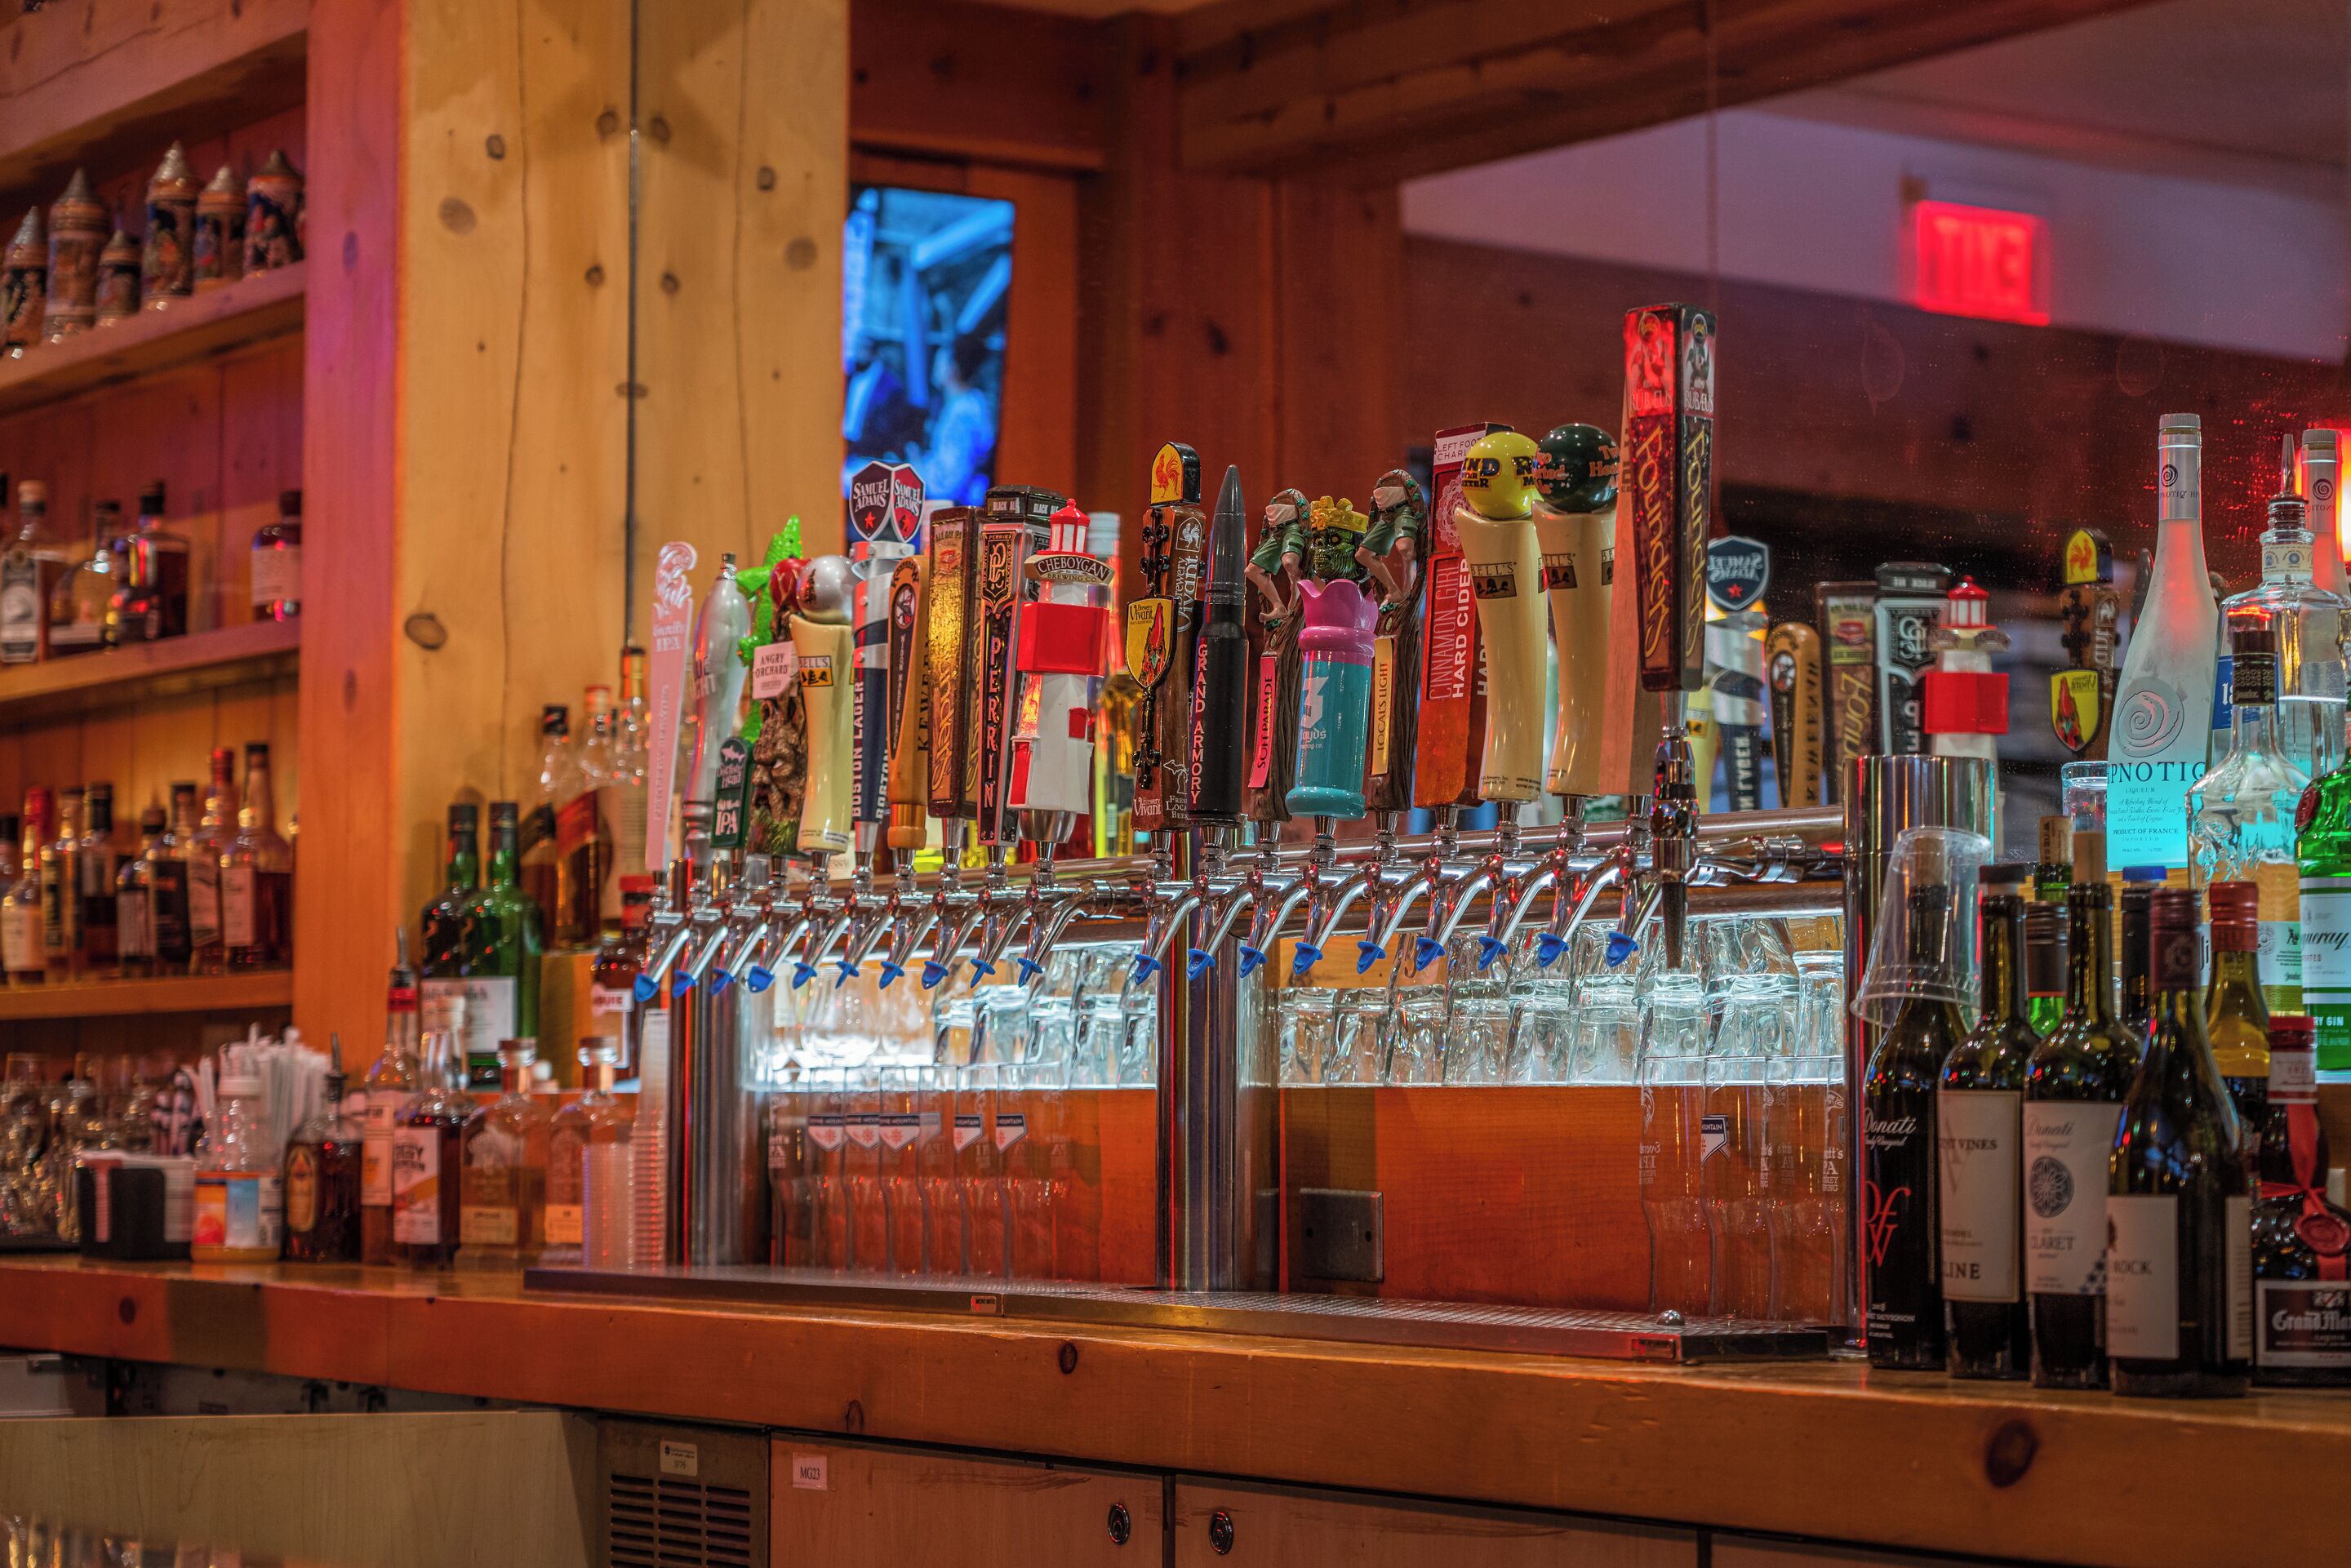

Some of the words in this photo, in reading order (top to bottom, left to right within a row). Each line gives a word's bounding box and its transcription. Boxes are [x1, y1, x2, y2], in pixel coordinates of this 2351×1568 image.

[1438, 442, 1458, 452] LEFT
[1438, 450, 1466, 460] CHARL
[1463, 458, 1500, 476] IND
[853, 478, 889, 500] SAMUEL
[894, 479, 922, 504] SAMUEL
[855, 493, 887, 513] ADAMS
[895, 496, 919, 516] ADAMS
[993, 500, 1007, 511] BLACK
[1033, 503, 1048, 513] BLACK
[1686, 429, 1706, 657] Founders
[1038, 556, 1109, 579] CHEBOYGAN
[1470, 563, 1514, 575] BELL'S
[1047, 574, 1083, 582] BREWING
[1436, 562, 1460, 600] GIRL
[1130, 604, 1153, 620] Vivant
[760, 654, 784, 665] ANGRY
[1429, 610, 1457, 700] CINNAMON
[755, 664, 789, 677] ORCHARD
[1452, 634, 1467, 698] HARD
[1195, 644, 1207, 713] GRAND
[1380, 662, 1388, 697] LIGHT
[854, 681, 864, 740] LAGER
[1262, 677, 1273, 732] PARADE
[984, 637, 1001, 808] PERRIN
[1378, 700, 1387, 751] LOCAL'S
[1257, 734, 1269, 768] SOFT
[1191, 721, 1205, 804] ARMORY
[722, 771, 742, 788] Head
[852, 746, 863, 817] BOSTON
[1134, 797, 1162, 816] Vivant
[1166, 801, 1186, 811] LOCA
[1170, 795, 1187, 803] FRES
[716, 810, 738, 836] IPA
[2313, 1016, 2323, 1025] RY
[2327, 1016, 2344, 1026] GIN
[1960, 1139, 1997, 1150] VINES
[1944, 1263, 1980, 1279] LINE
[2272, 1309, 2321, 1330] Grand
[800, 1467, 820, 1480] MG23
